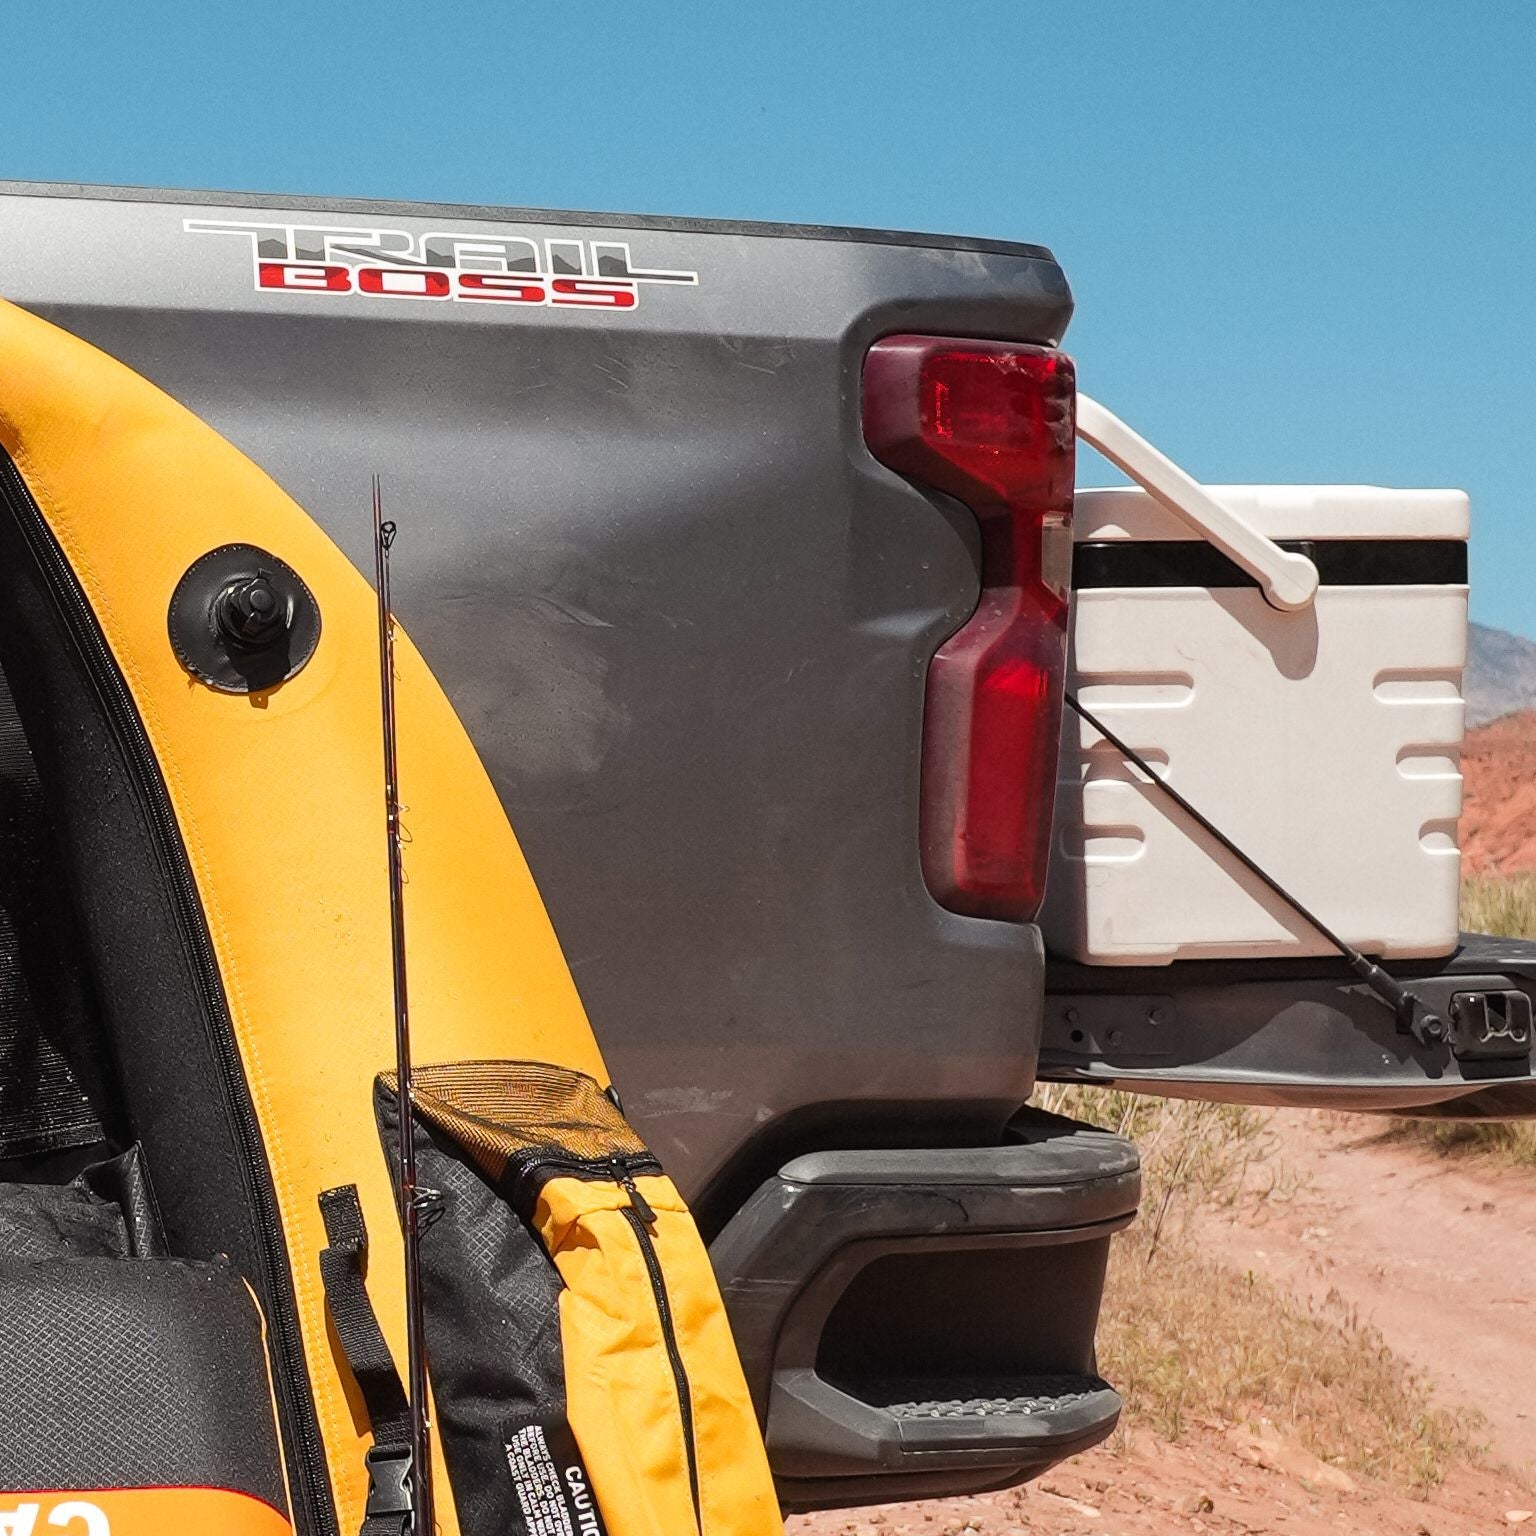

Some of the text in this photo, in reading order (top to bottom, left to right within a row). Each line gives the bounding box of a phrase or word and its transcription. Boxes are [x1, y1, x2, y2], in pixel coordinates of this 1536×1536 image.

[183, 218, 699, 287] TRAIL
[254, 261, 640, 312] BOSS
[504, 1443, 513, 1453] A
[511, 1432, 525, 1455] USE
[517, 1427, 529, 1448] THE
[524, 1425, 543, 1463] BEFORE
[506, 1450, 523, 1482] COAST
[515, 1452, 532, 1479] ONLY
[532, 1425, 551, 1462] ALWAYS
[545, 1461, 562, 1495] CHECK
[523, 1479, 534, 1492] IN
[543, 1484, 555, 1499] DO
[515, 1482, 532, 1515] GUARD
[527, 1490, 543, 1519] CALM
[539, 1500, 550, 1515] DO
[548, 1499, 561, 1519] NOT
[543, 1514, 556, 1535] NOT
